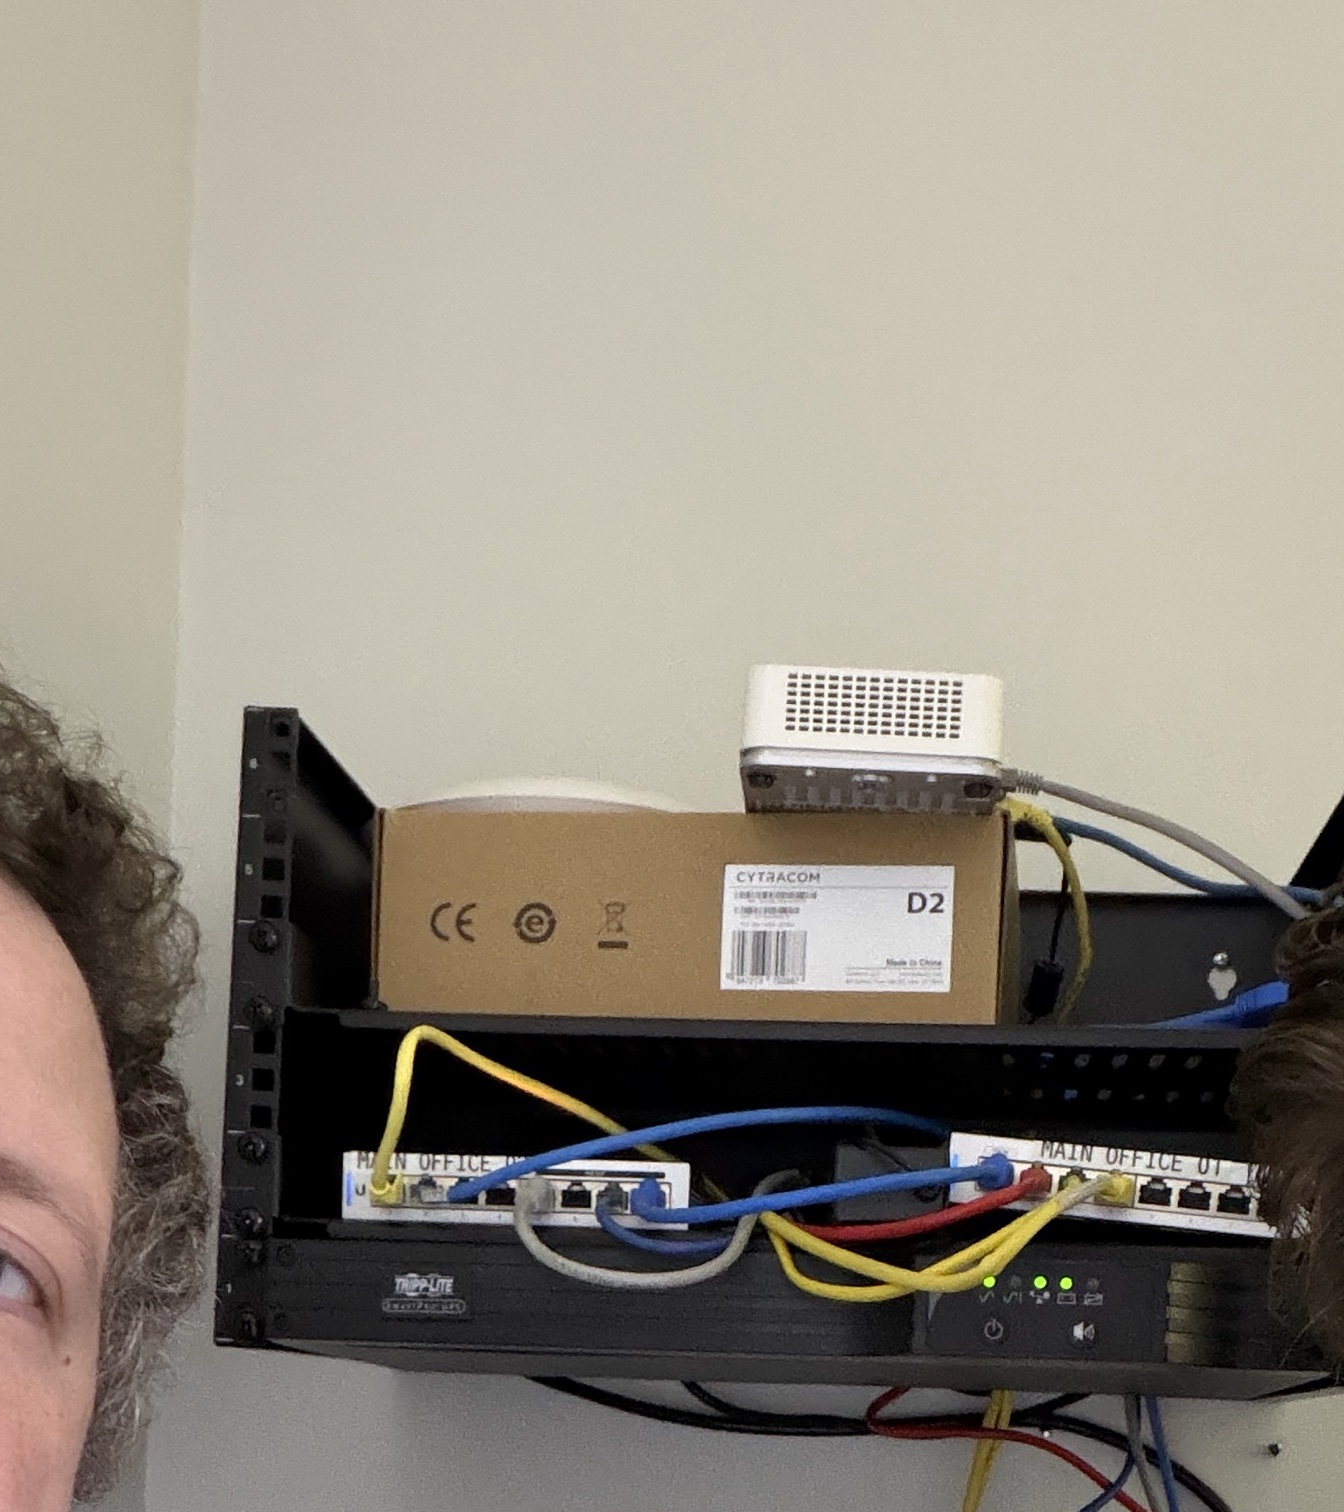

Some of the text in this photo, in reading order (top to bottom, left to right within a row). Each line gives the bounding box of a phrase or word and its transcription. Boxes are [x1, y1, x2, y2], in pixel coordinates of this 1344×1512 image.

[736, 871, 821, 883] CYTRACOM
[907, 891, 945, 914] D2
[419, 1152, 490, 1173] OFFICE
[1040, 1140, 1094, 1163] MAIN
[1105, 1146, 1183, 1173] OFFICE
